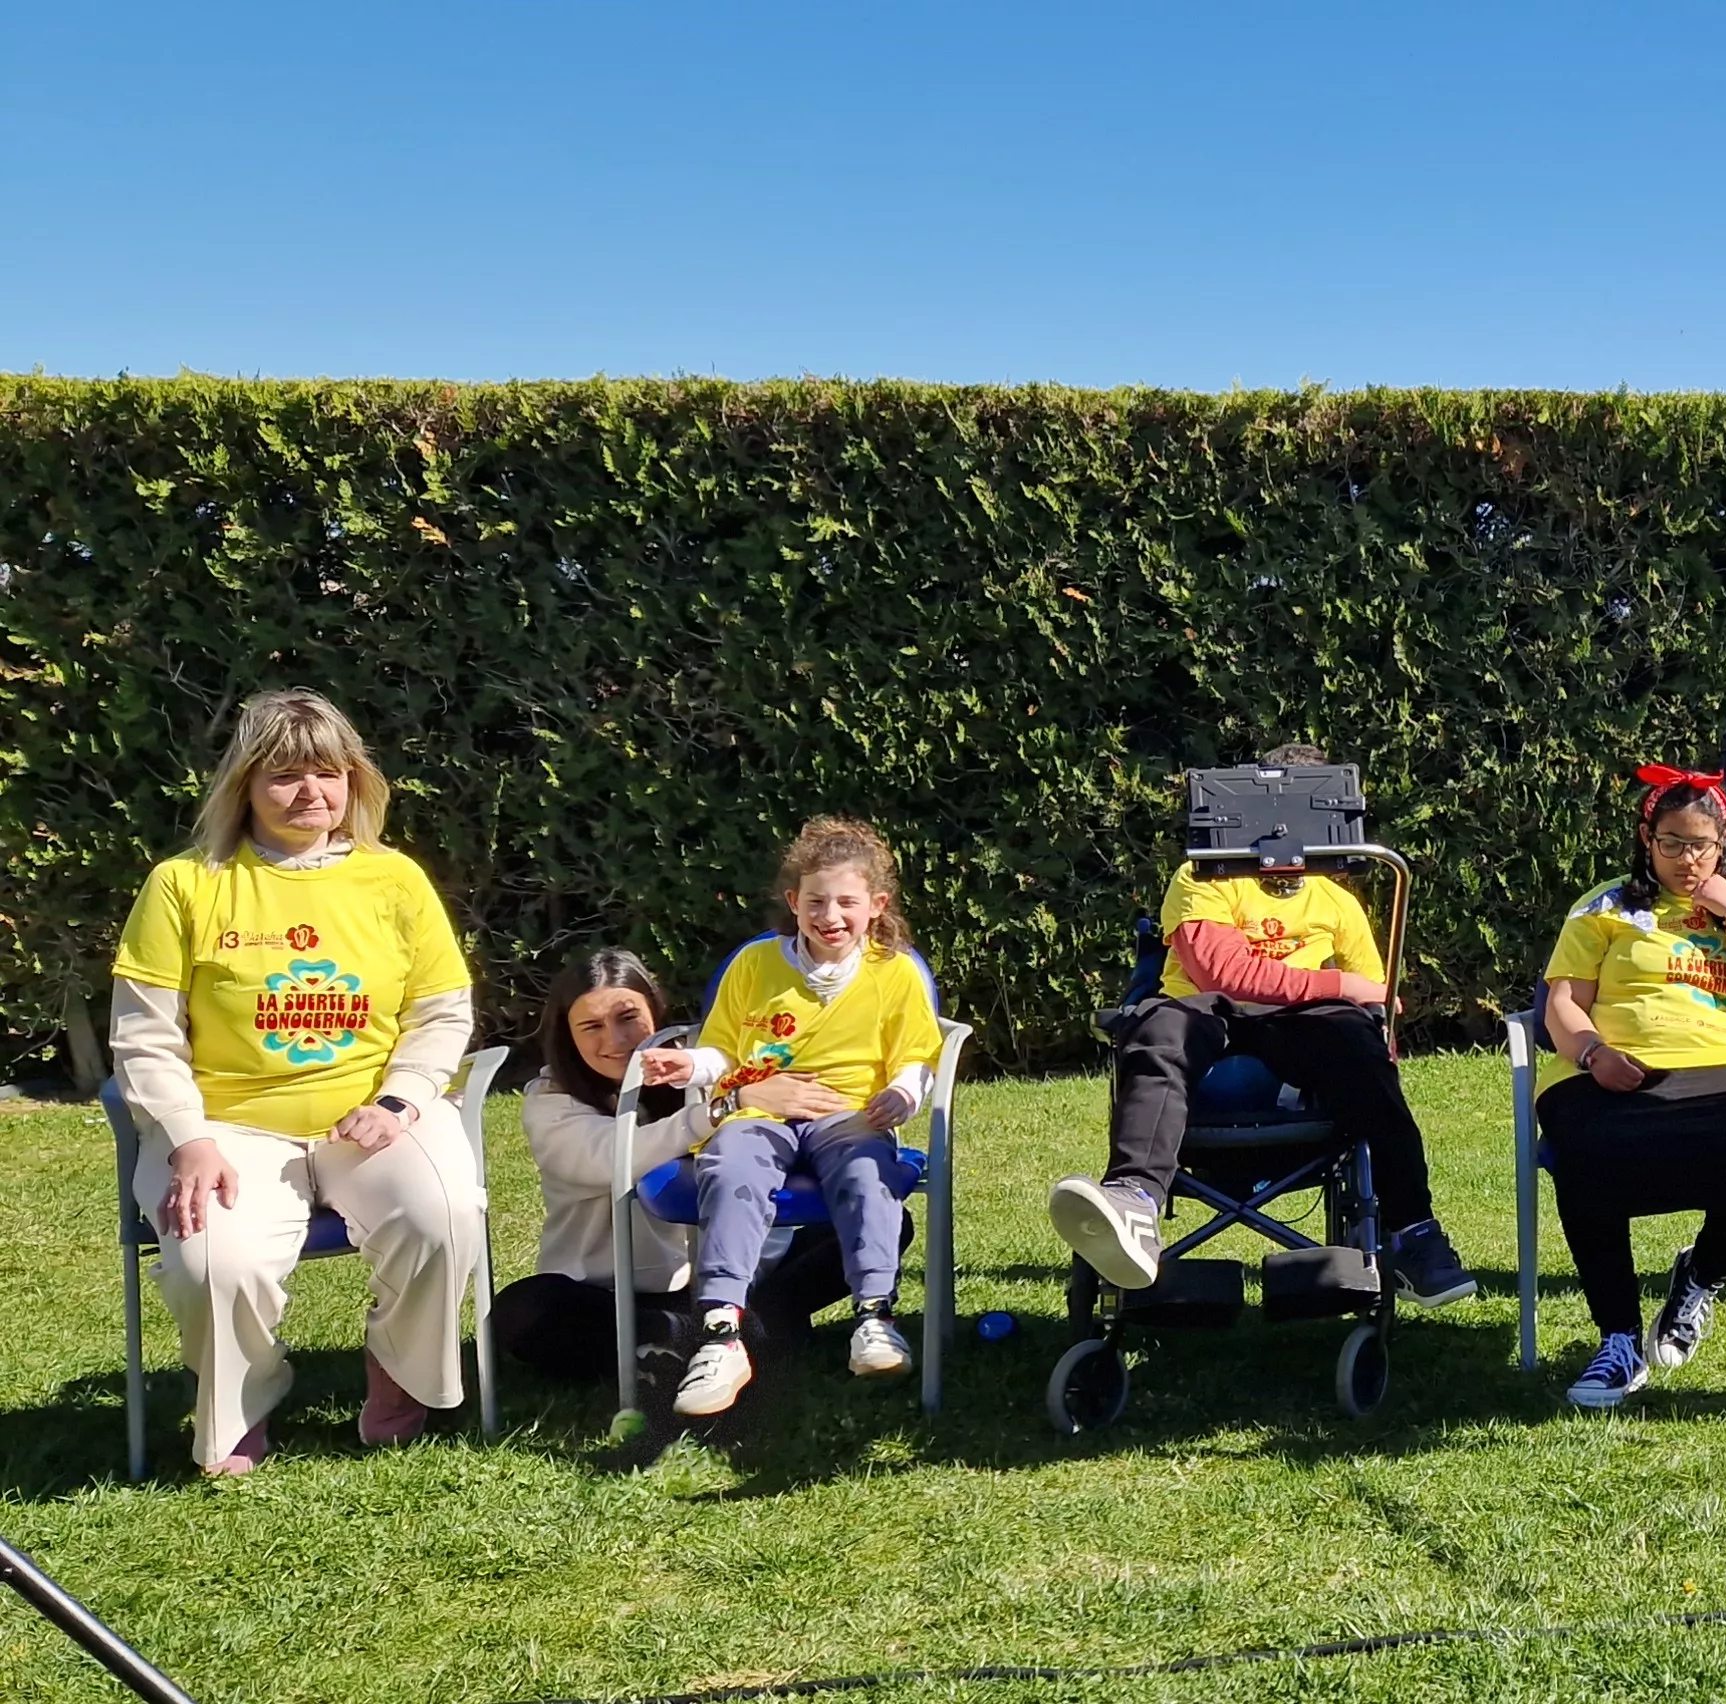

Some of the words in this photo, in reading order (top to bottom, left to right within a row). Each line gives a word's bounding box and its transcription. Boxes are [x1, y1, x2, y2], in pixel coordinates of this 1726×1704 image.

[1668, 957, 1682, 970] LA
[256, 994, 278, 1012] LA
[284, 994, 345, 1011] SUERTE
[351, 995, 369, 1011] DE
[254, 1012, 369, 1029] CONOCERNOS
